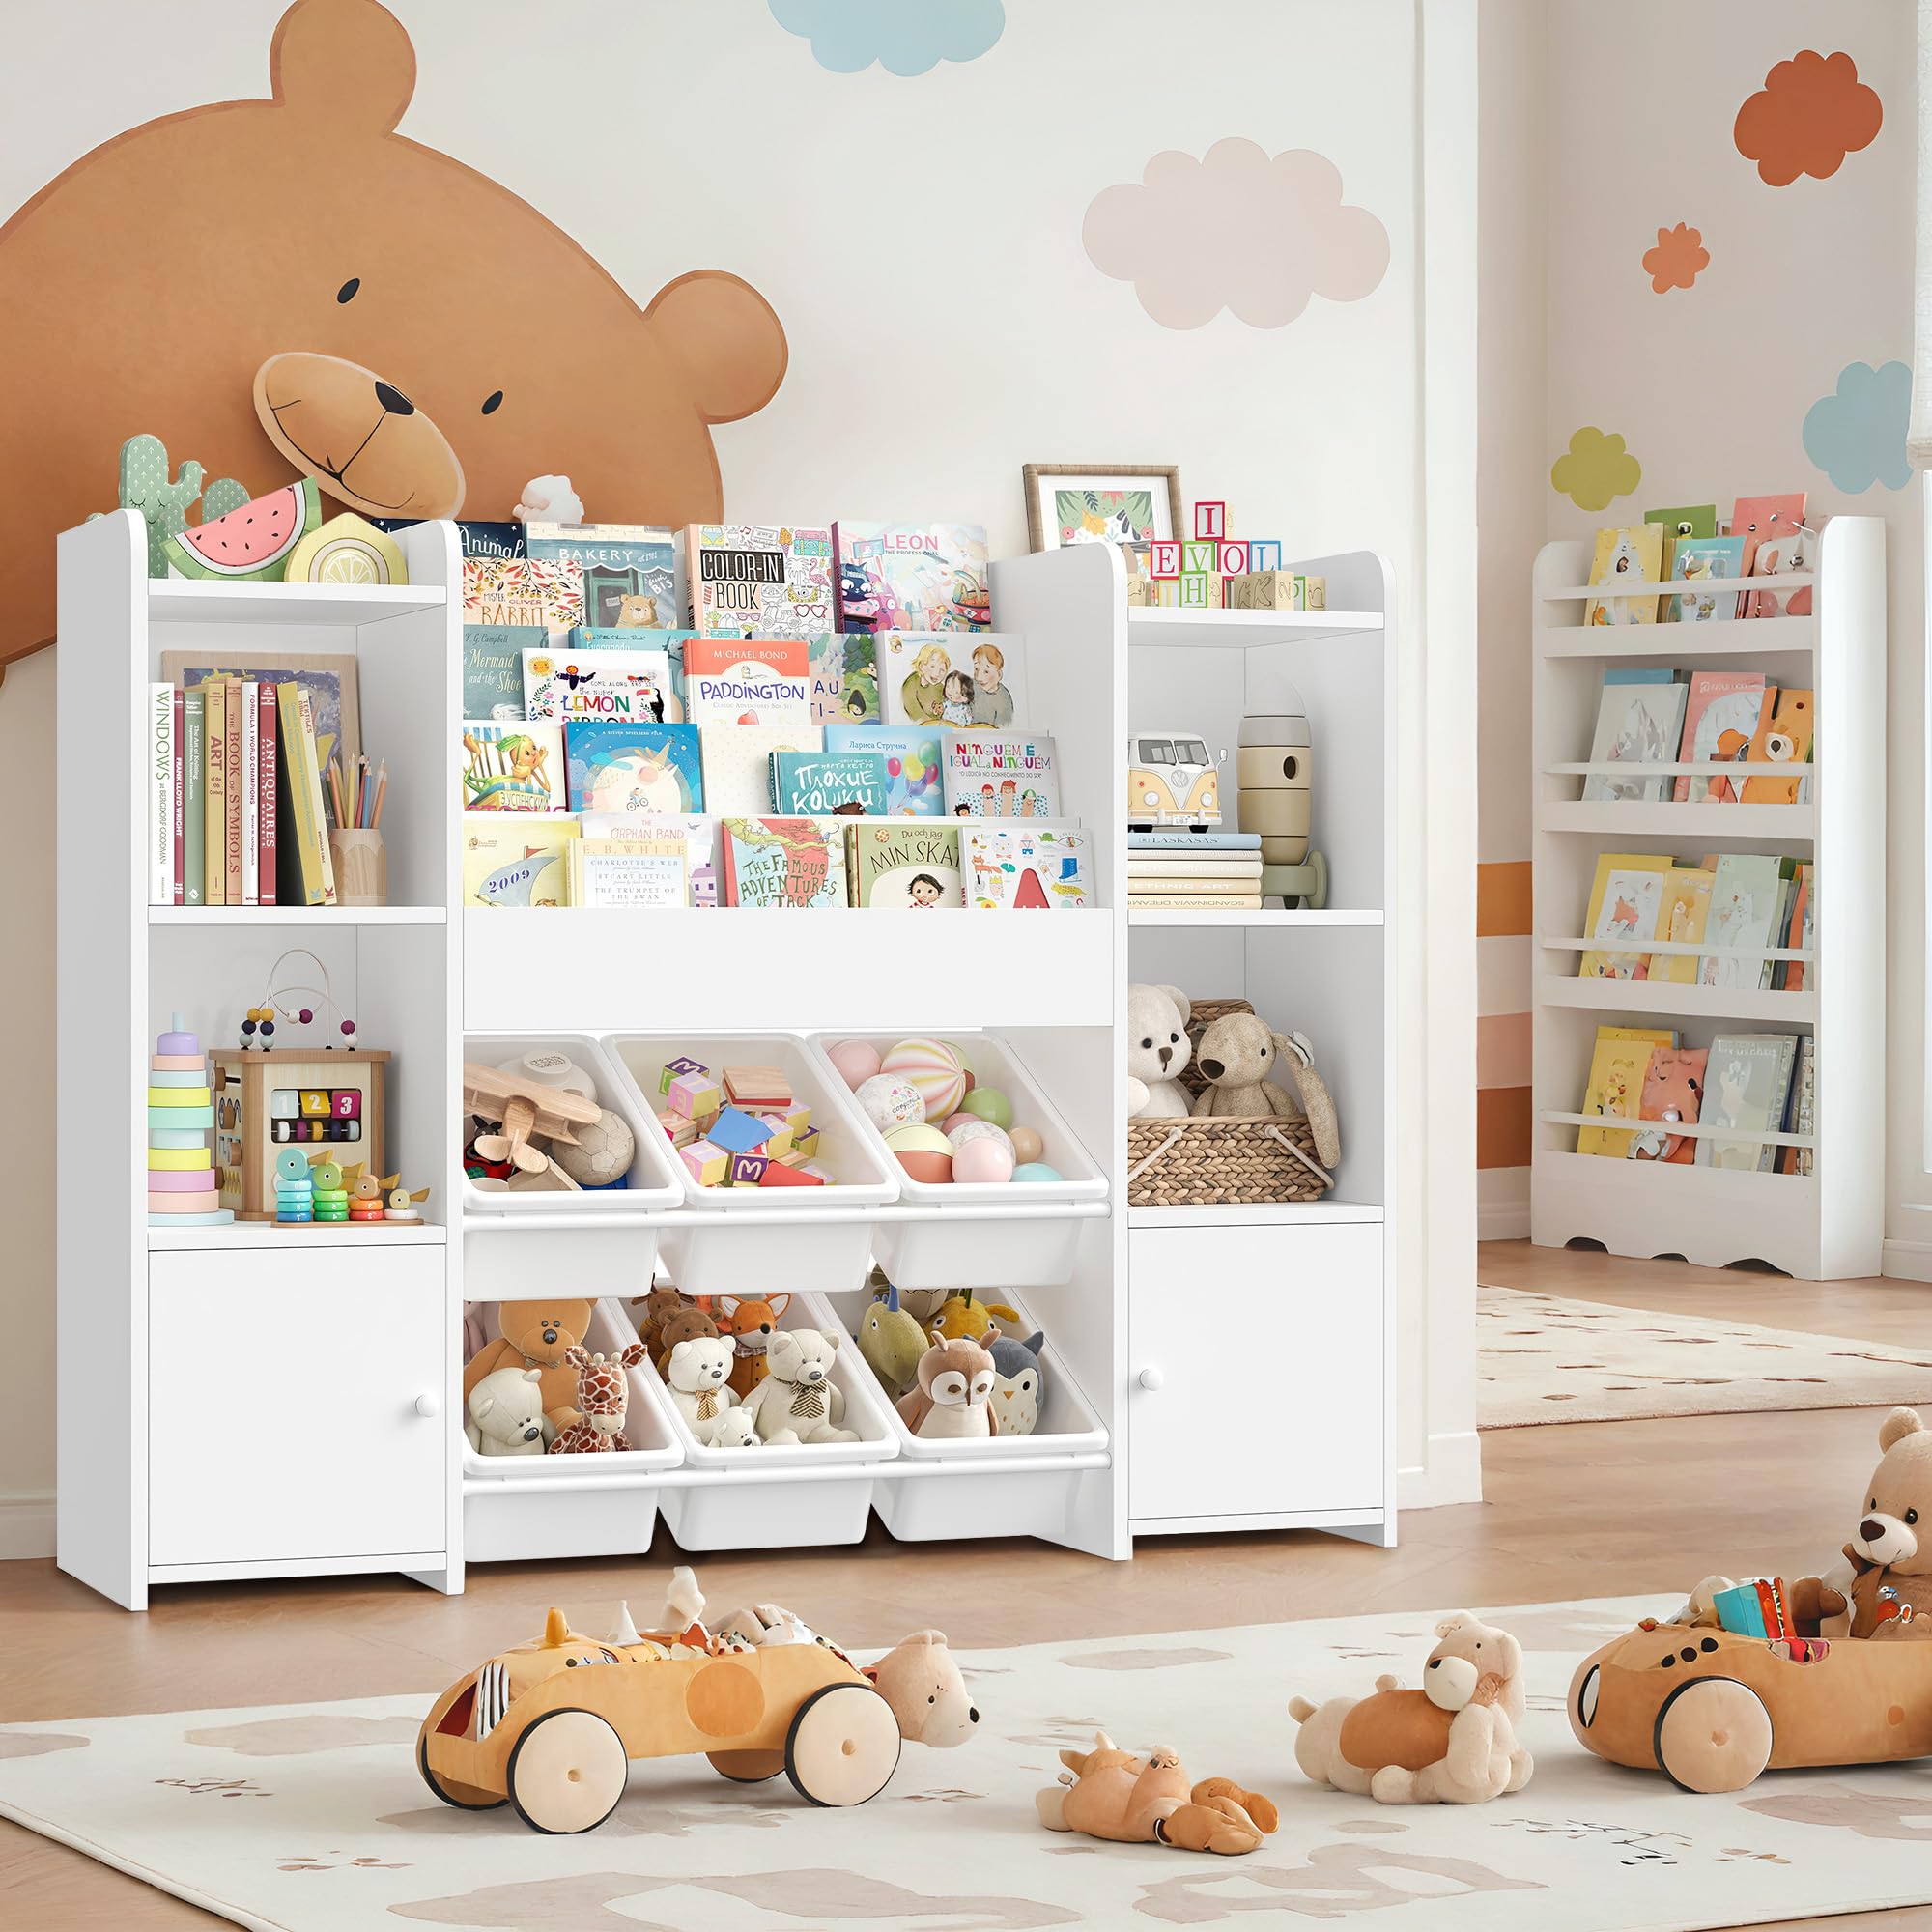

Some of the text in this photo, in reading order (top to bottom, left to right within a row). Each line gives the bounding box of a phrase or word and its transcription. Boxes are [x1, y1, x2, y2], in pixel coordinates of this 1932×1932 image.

[883, 534, 939, 551] LEON
[558, 548, 634, 562] BAKERY
[651, 579, 673, 595] BIS
[715, 582, 759, 610] BOOK
[481, 604, 549, 627] RABBIT
[481, 632, 509, 645] Campbell
[468, 648, 519, 669] Mermaid
[713, 649, 788, 661] MICHAEL BOND
[469, 670, 522, 694] and the Shoe
[700, 681, 805, 700] PADDINGTON
[560, 695, 631, 713] LEMON
[302, 699, 313, 734] TEXTILES
[156, 690, 171, 781] WINDOWS
[849, 740, 875, 751] Лариса
[210, 735, 223, 771] ART
[229, 732, 241, 777] BOOK
[955, 742, 1022, 756] NINGUÉM
[950, 755, 981, 769] IGUAL
[992, 754, 1051, 770] NINGUÉM
[265, 738, 275, 848] ANTIQUAIRES
[229, 794, 241, 874] SYMBOLS
[611, 826, 685, 840] ORPHAN BAND
[901, 829, 943, 840] Du och jag
[582, 844, 685, 855] E. B. WHITE
[870, 843, 910, 874] MIN
[742, 853, 825, 877] THE FAMOUS
[488, 869, 530, 893] 2009
[740, 874, 838, 903] ADVENTURES
[757, 895, 769, 907] OF
[278, 1094, 353, 1115] 1 2 3
[737, 1159, 762, 1180] M
